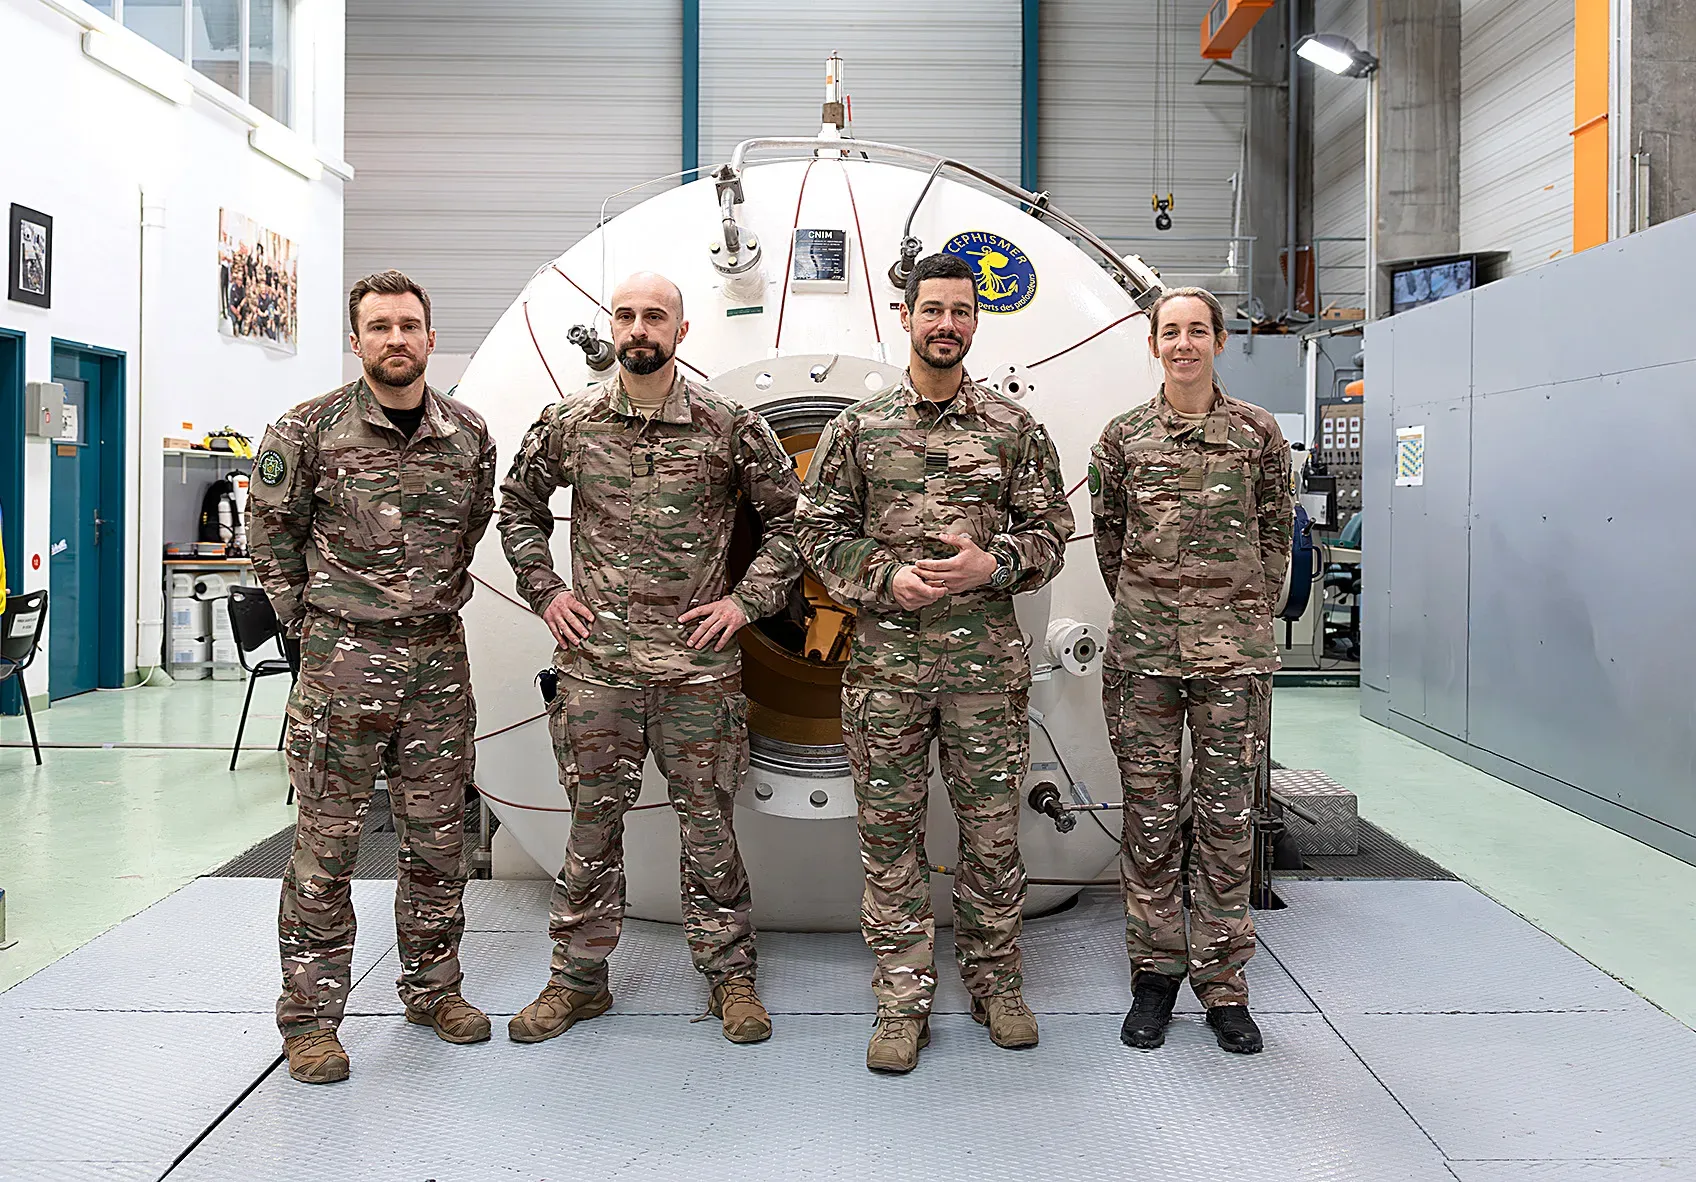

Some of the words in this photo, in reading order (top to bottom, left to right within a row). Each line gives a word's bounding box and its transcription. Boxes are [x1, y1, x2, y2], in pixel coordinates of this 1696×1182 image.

[808, 231, 833, 239] CNIM
[947, 232, 1027, 264] CEPHISMER
[1000, 303, 1014, 311] des
[1014, 273, 1035, 309] profondeurs
